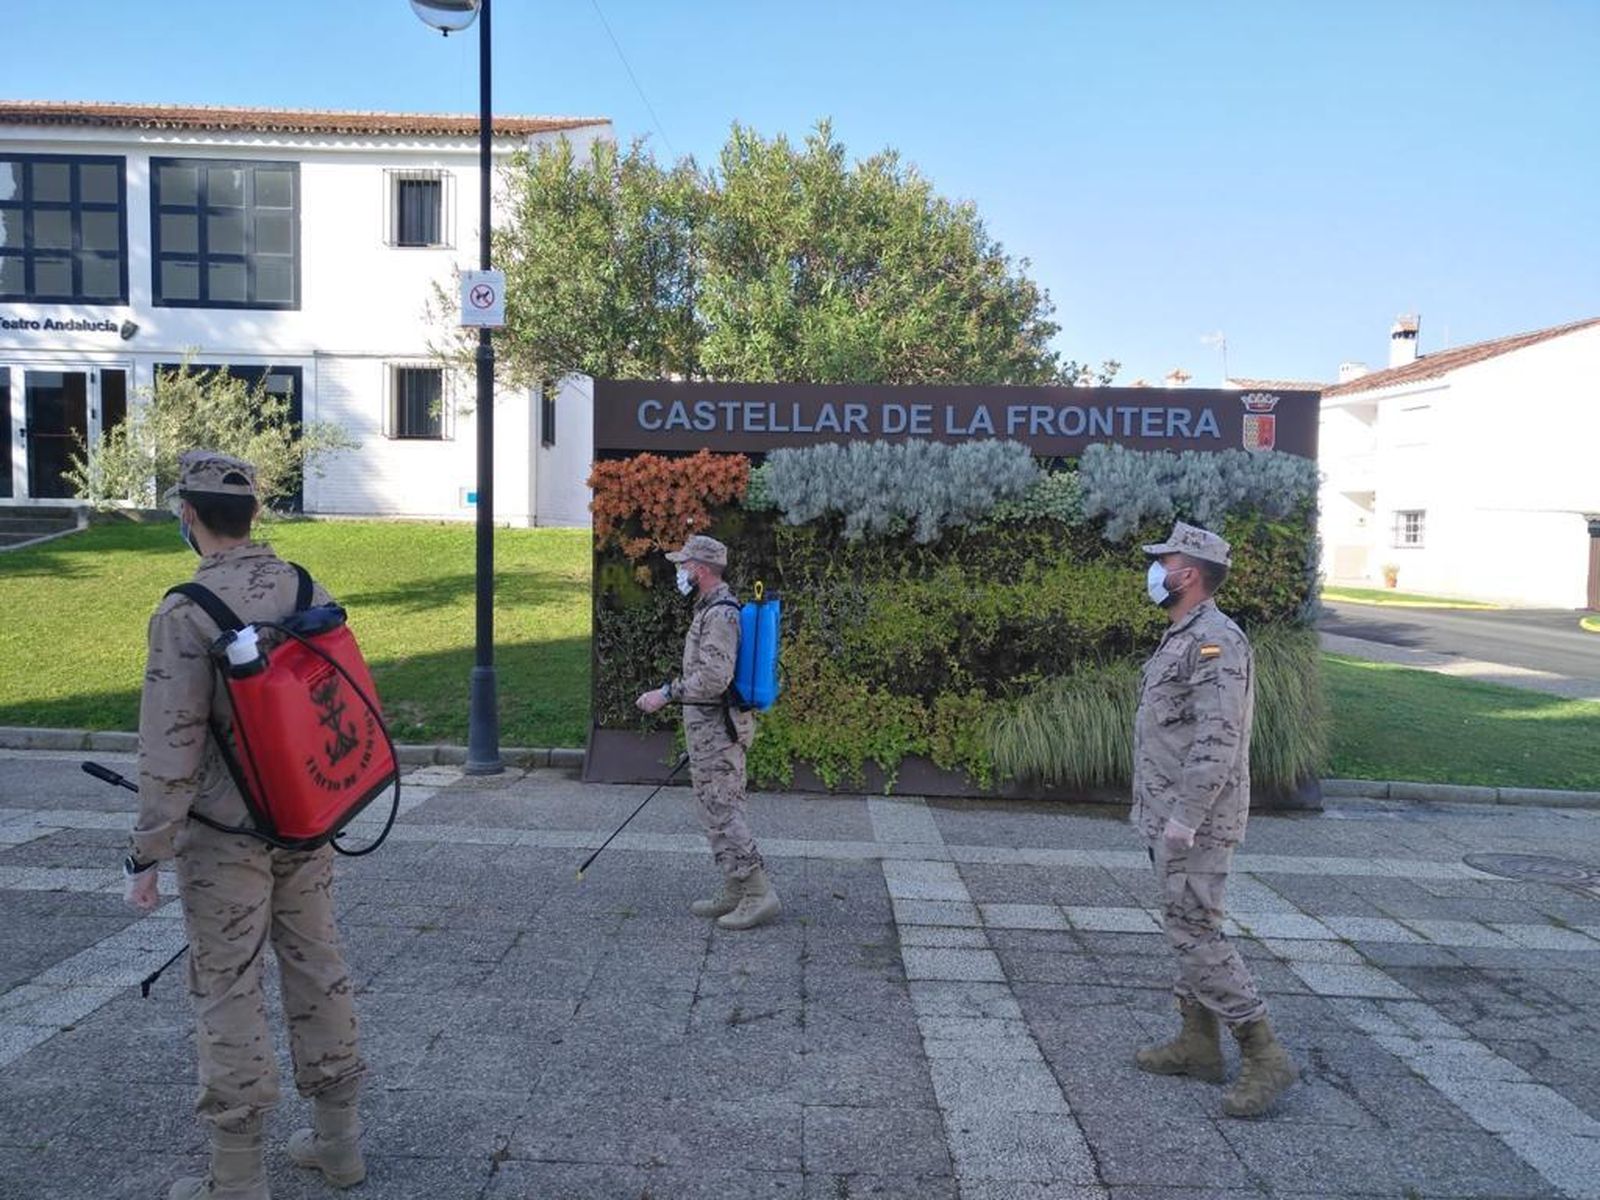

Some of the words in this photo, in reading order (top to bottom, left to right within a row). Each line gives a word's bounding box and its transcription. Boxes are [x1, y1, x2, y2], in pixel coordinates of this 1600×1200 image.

[637, 400, 870, 433] CASTELLAR
[881, 403, 933, 434] DE
[945, 405, 995, 435] LA
[1007, 405, 1221, 438] FRONTERA
